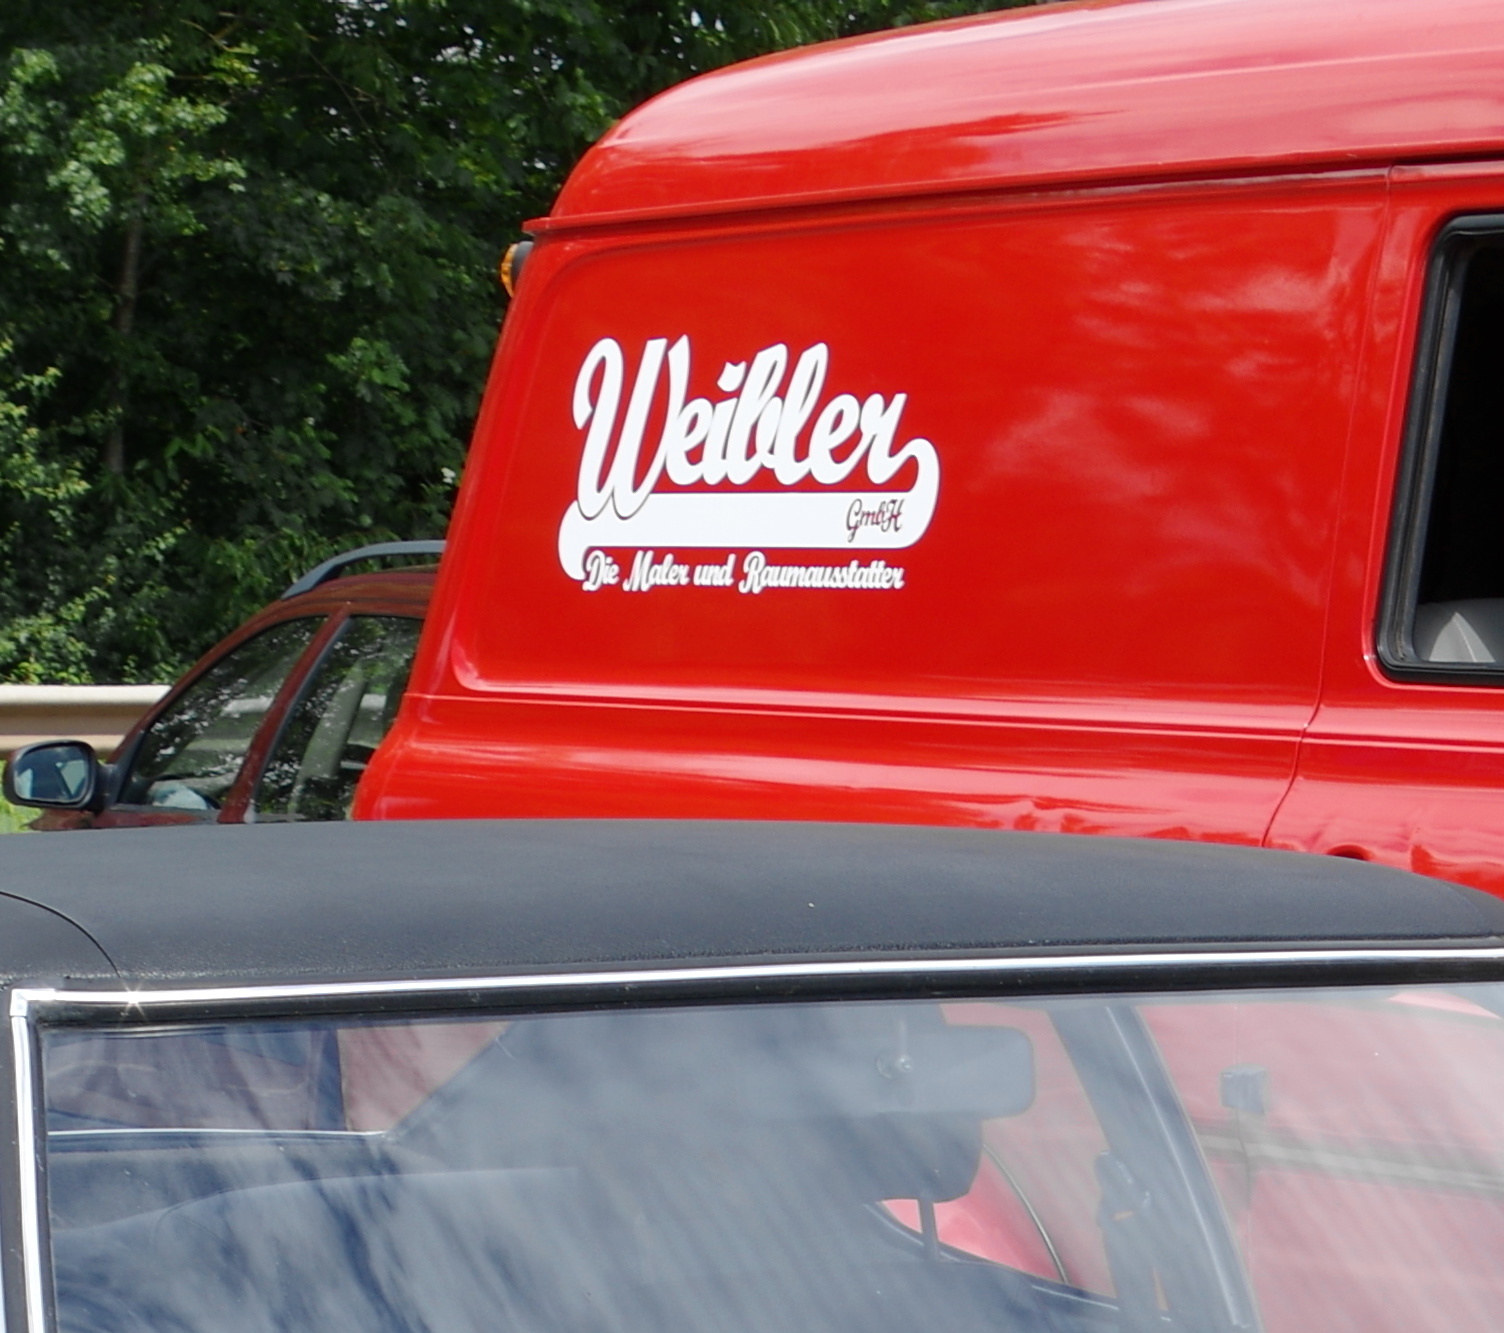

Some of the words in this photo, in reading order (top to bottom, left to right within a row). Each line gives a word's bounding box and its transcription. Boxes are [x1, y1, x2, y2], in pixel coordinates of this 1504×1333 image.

[845, 498, 905, 542] GmbH
[582, 550, 618, 591] Die
[622, 550, 690, 592] Maler
[693, 553, 735, 586] und
[737, 551, 905, 594] Raumausstatter
